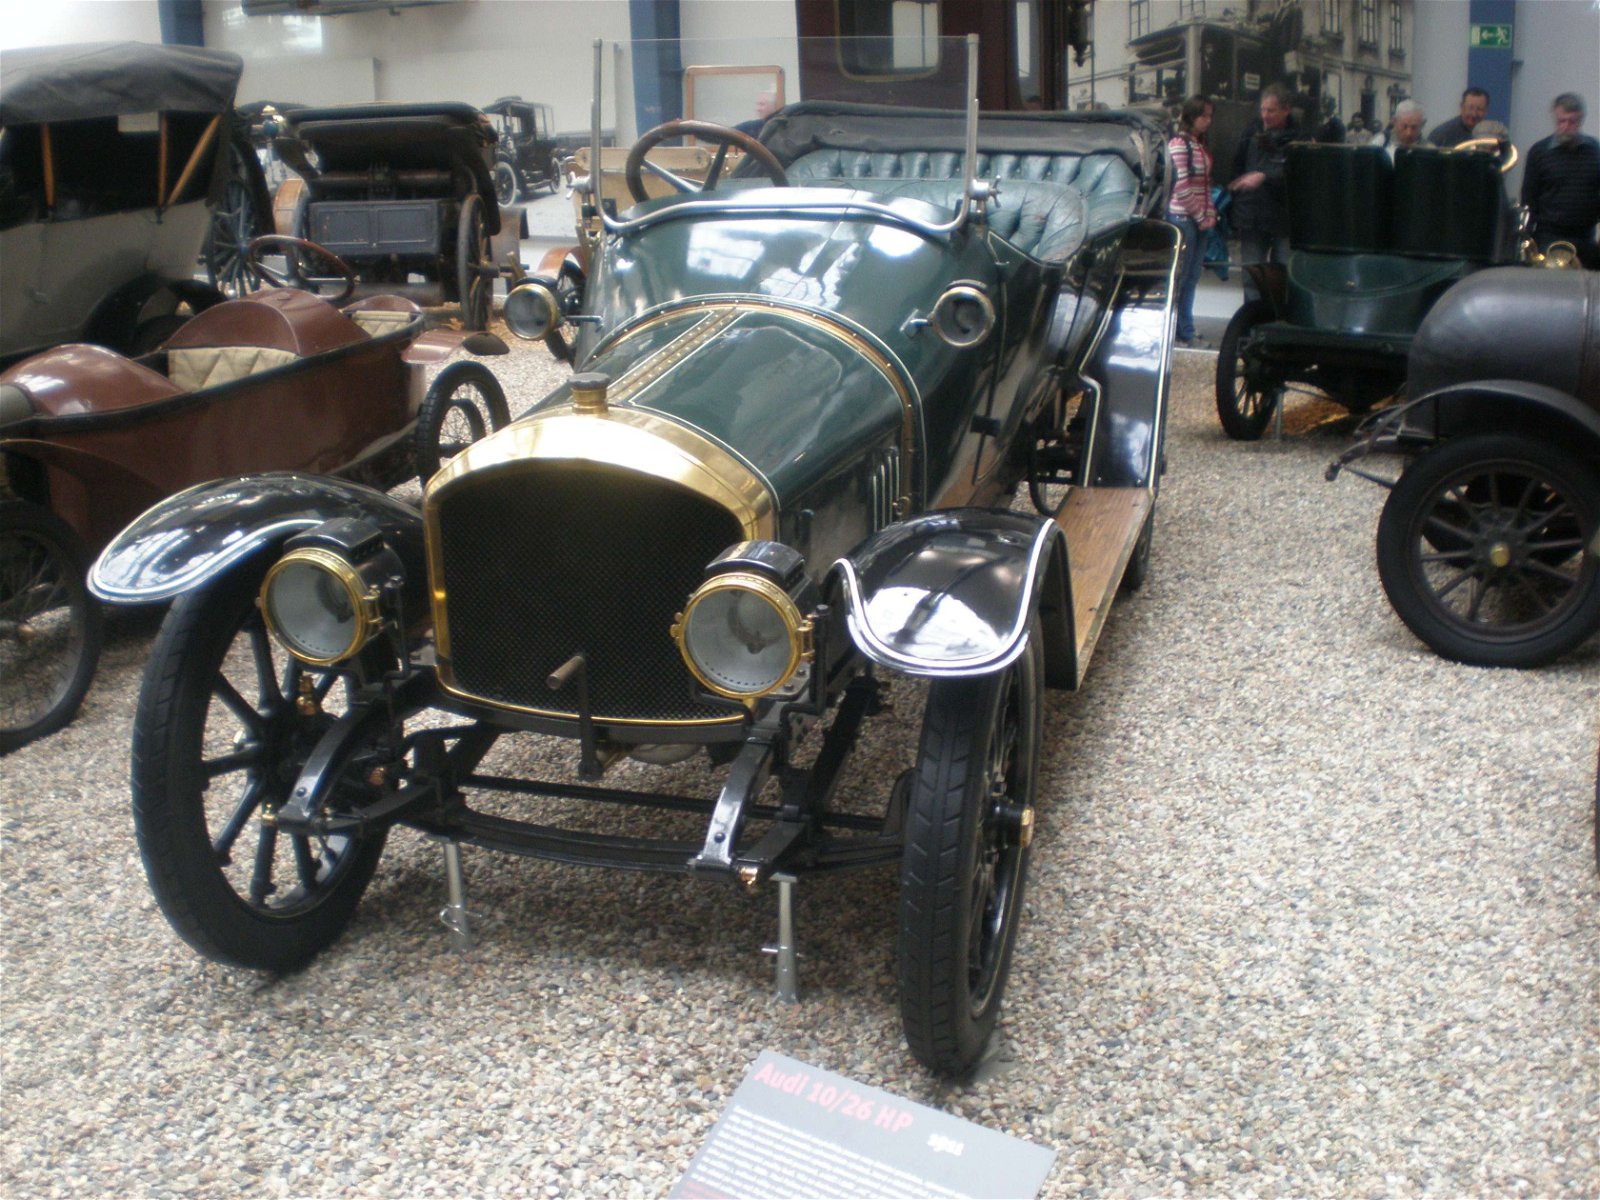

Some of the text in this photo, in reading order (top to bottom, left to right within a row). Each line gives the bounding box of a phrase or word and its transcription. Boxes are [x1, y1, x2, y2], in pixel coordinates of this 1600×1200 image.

[753, 1063, 914, 1132] Audi 10/26 HP
